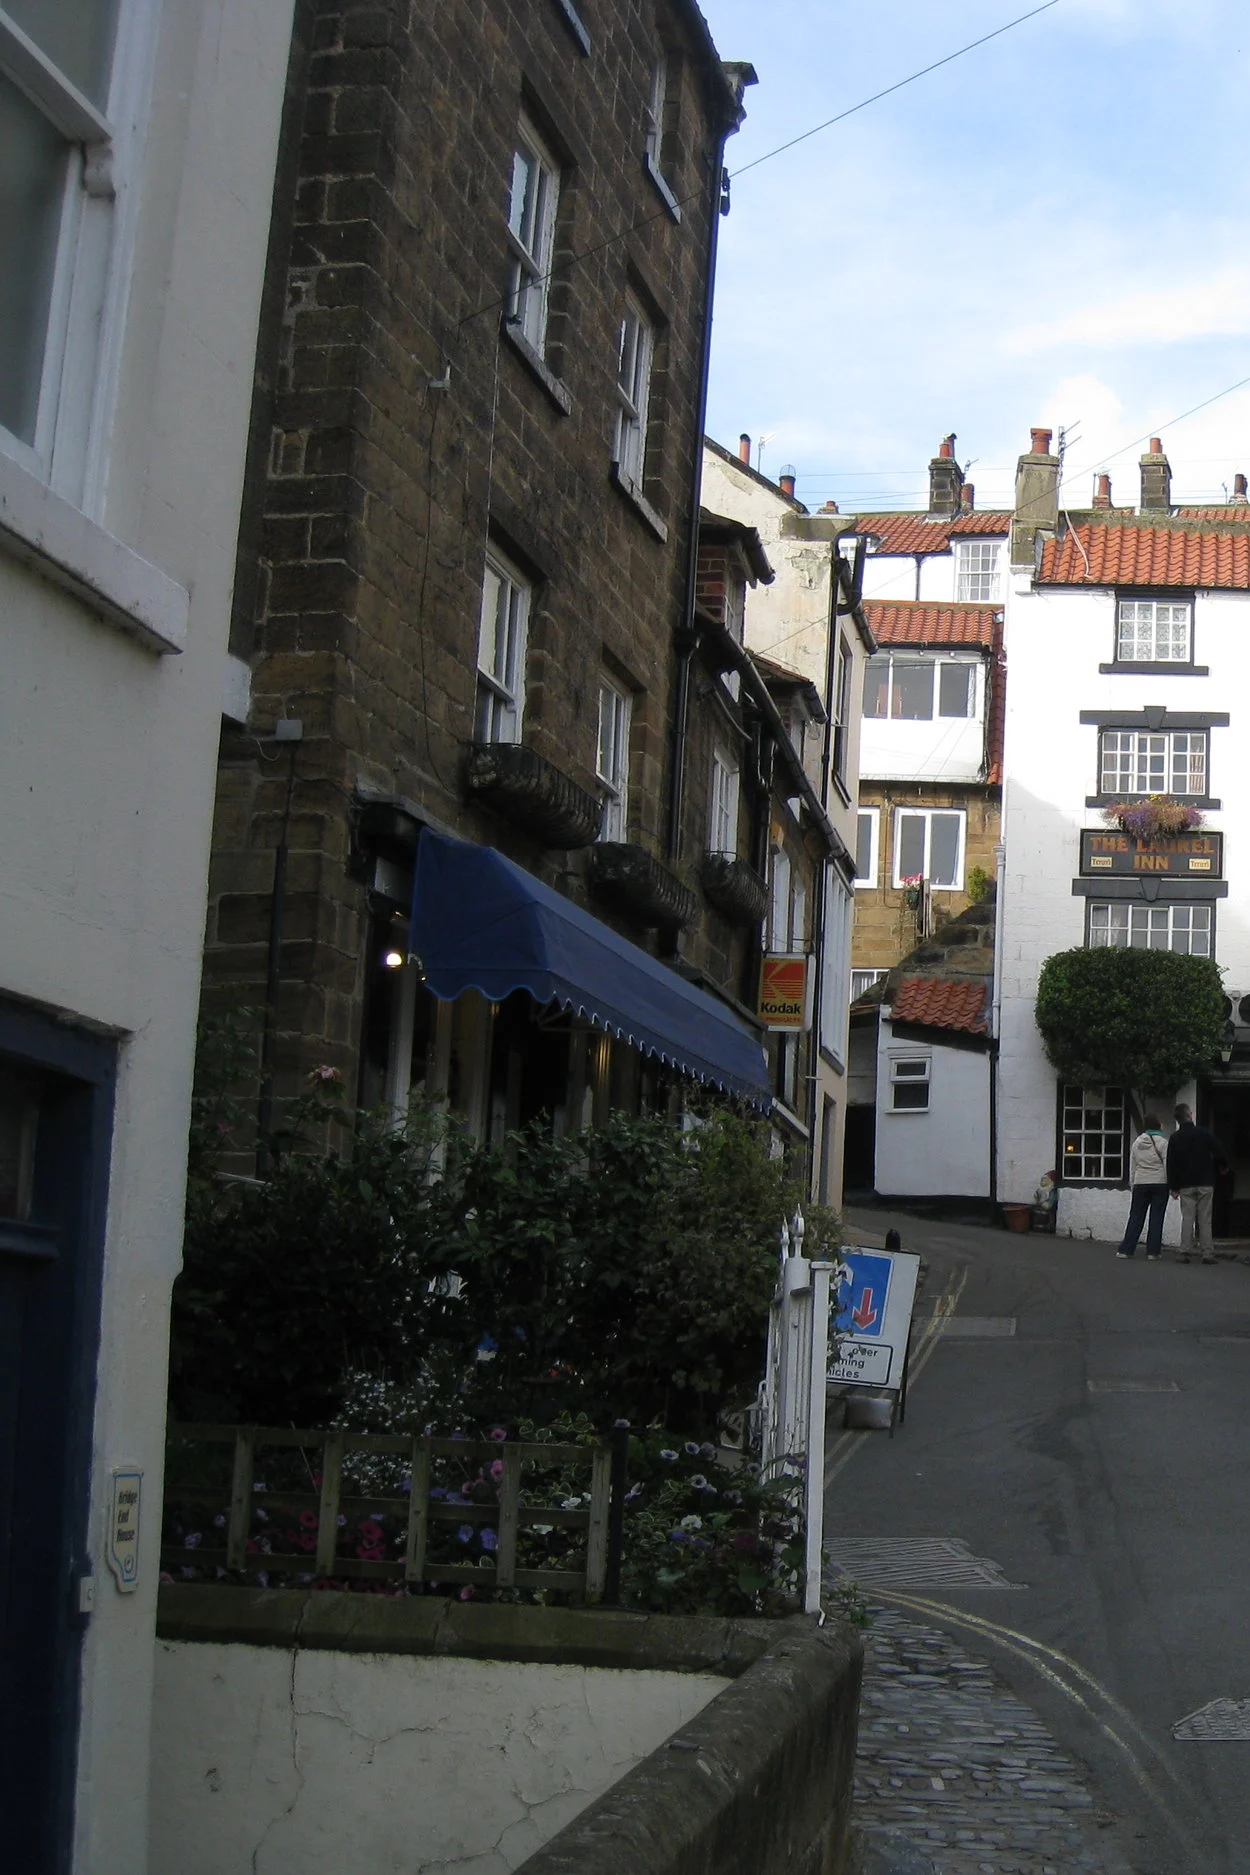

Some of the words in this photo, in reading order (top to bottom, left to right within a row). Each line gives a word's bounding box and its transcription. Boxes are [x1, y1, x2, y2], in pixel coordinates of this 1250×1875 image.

[1090, 837, 1128, 852] THE
[1134, 855, 1169, 870] INN
[760, 1002, 801, 1014] Kodak
[852, 1347, 878, 1358] oer
